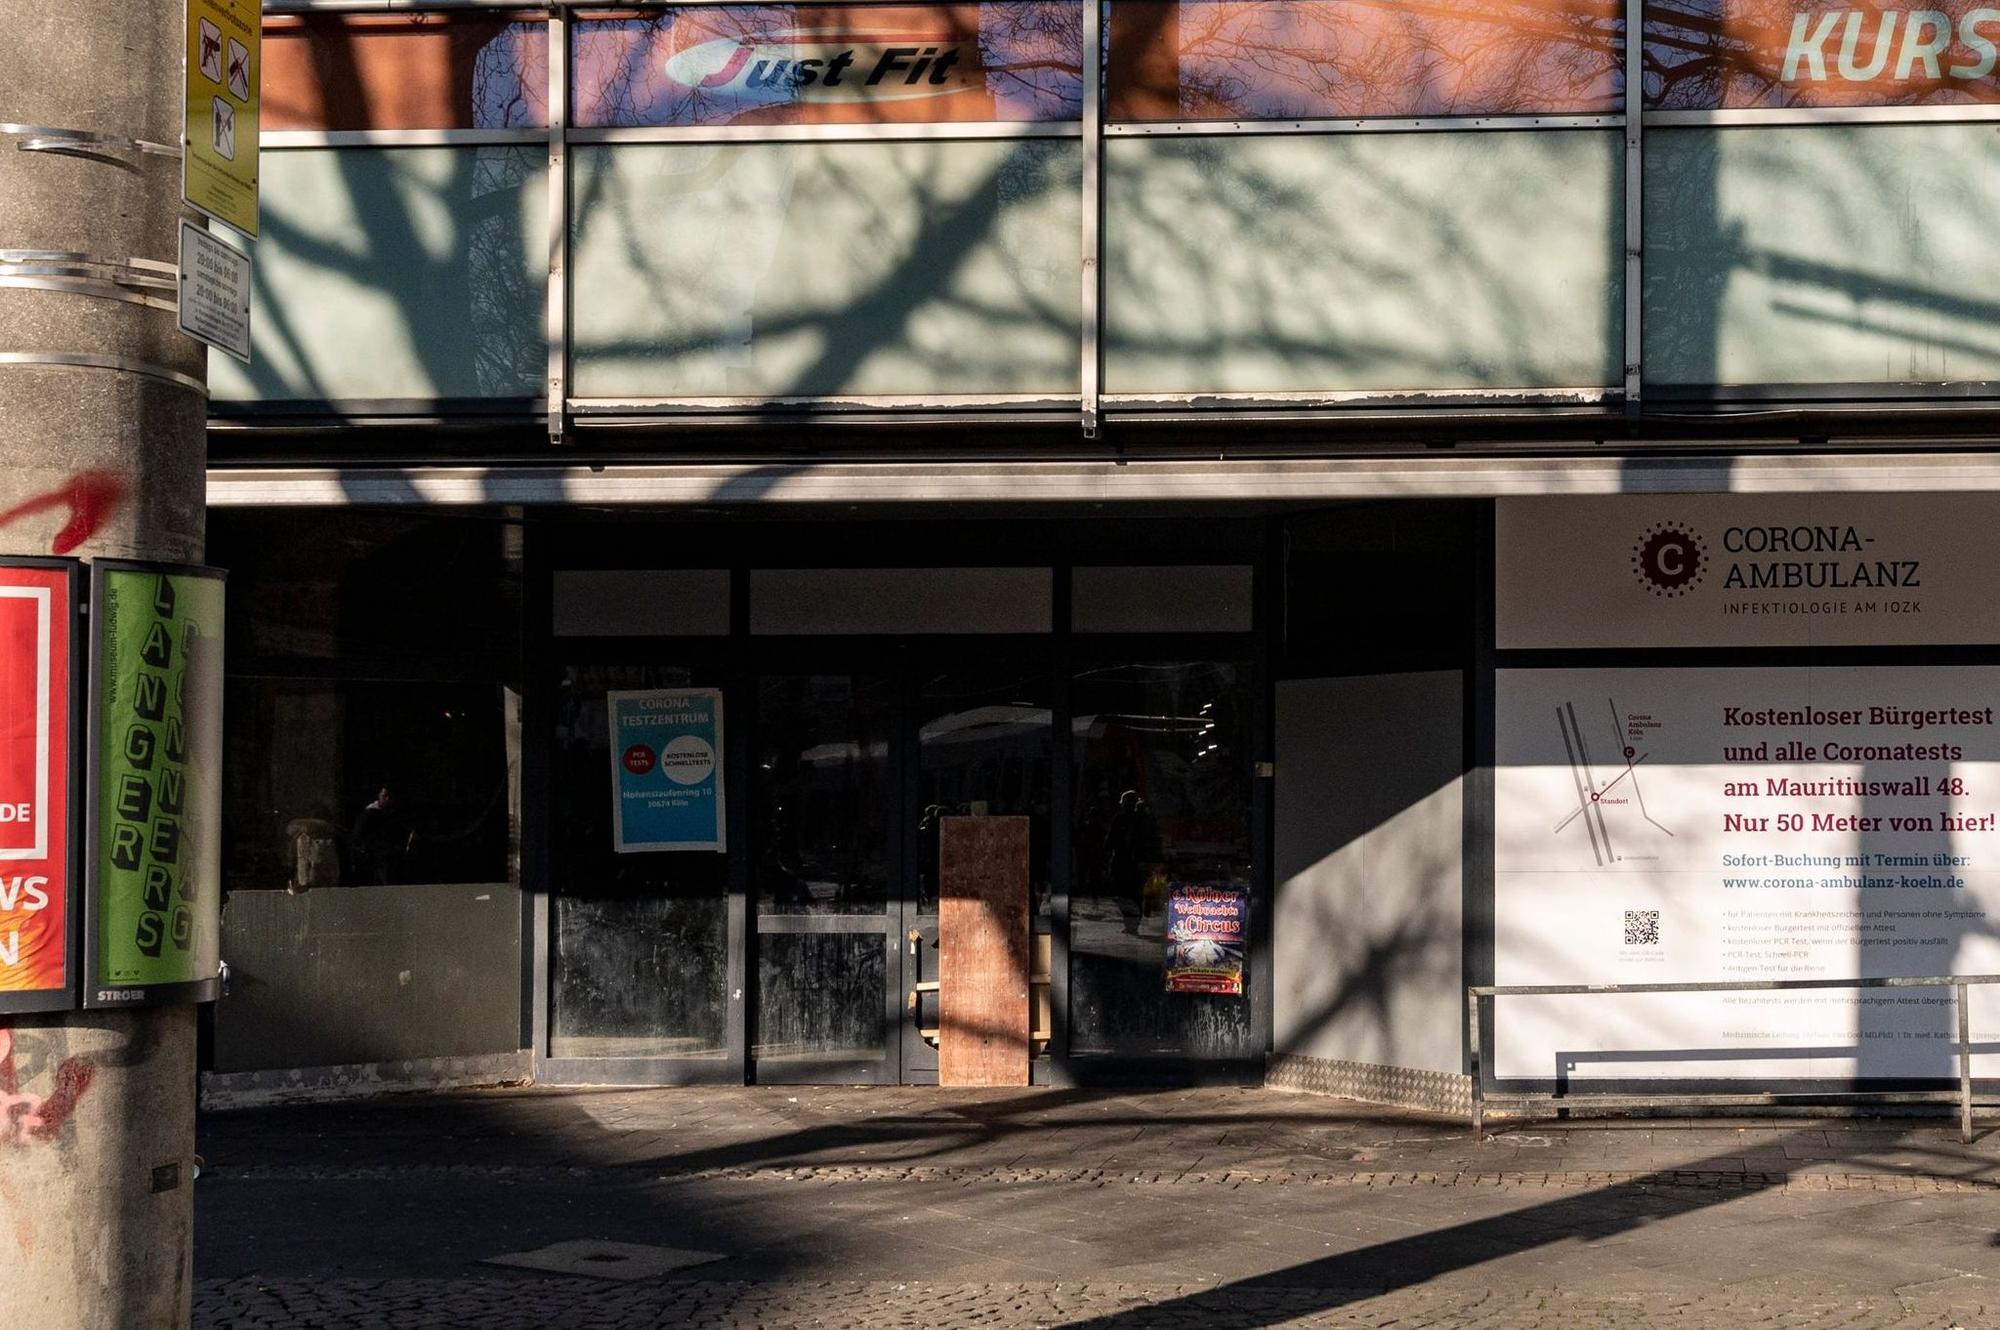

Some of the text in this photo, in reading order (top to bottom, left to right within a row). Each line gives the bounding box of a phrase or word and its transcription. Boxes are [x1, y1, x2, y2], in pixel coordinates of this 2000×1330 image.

[1780, 9, 2000, 82] KURS
[700, 47, 960, 87] Just Fit
[1723, 526, 1875, 553] CORONA-
[1723, 561, 1921, 589] AMBULANZ
[1723, 601, 1922, 614] INFEKTIOLOGIE AM IOZK
[110, 588, 119, 704] www.museum-ludwig.de
[640, 697, 690, 709] CORONA
[622, 711, 709, 726] TESTZENTRUM
[1723, 705, 1993, 731] Kostenloser Bürgertest
[632, 751, 646, 759] PCR
[666, 751, 709, 760] KOSTENLOSE
[1723, 742, 1962, 762] und alle Coronatests
[630, 759, 649, 767] TESTS
[664, 758, 711, 767] SCHNELLTESTS
[623, 787, 712, 799] Hohenstaufenring 10
[1724, 777, 1970, 797] am Mauritiuswall 48.
[1723, 812, 1996, 832] Nur 50 Meter von hier!
[1722, 853, 1971, 870] Sofort-Buchung mit Termin über:
[1722, 875, 1965, 889] www.corona-ambulanz-koeln.de
[1866, 910, 1881, 919] und
[1883, 910, 1920, 919] Personen
[1922, 910, 1942, 919] ohne
[1944, 910, 1986, 921] Symptome
[1185, 915, 1241, 933] Circus
[1873, 924, 1896, 932] Attest
[1896, 997, 1919, 1005] Attest
